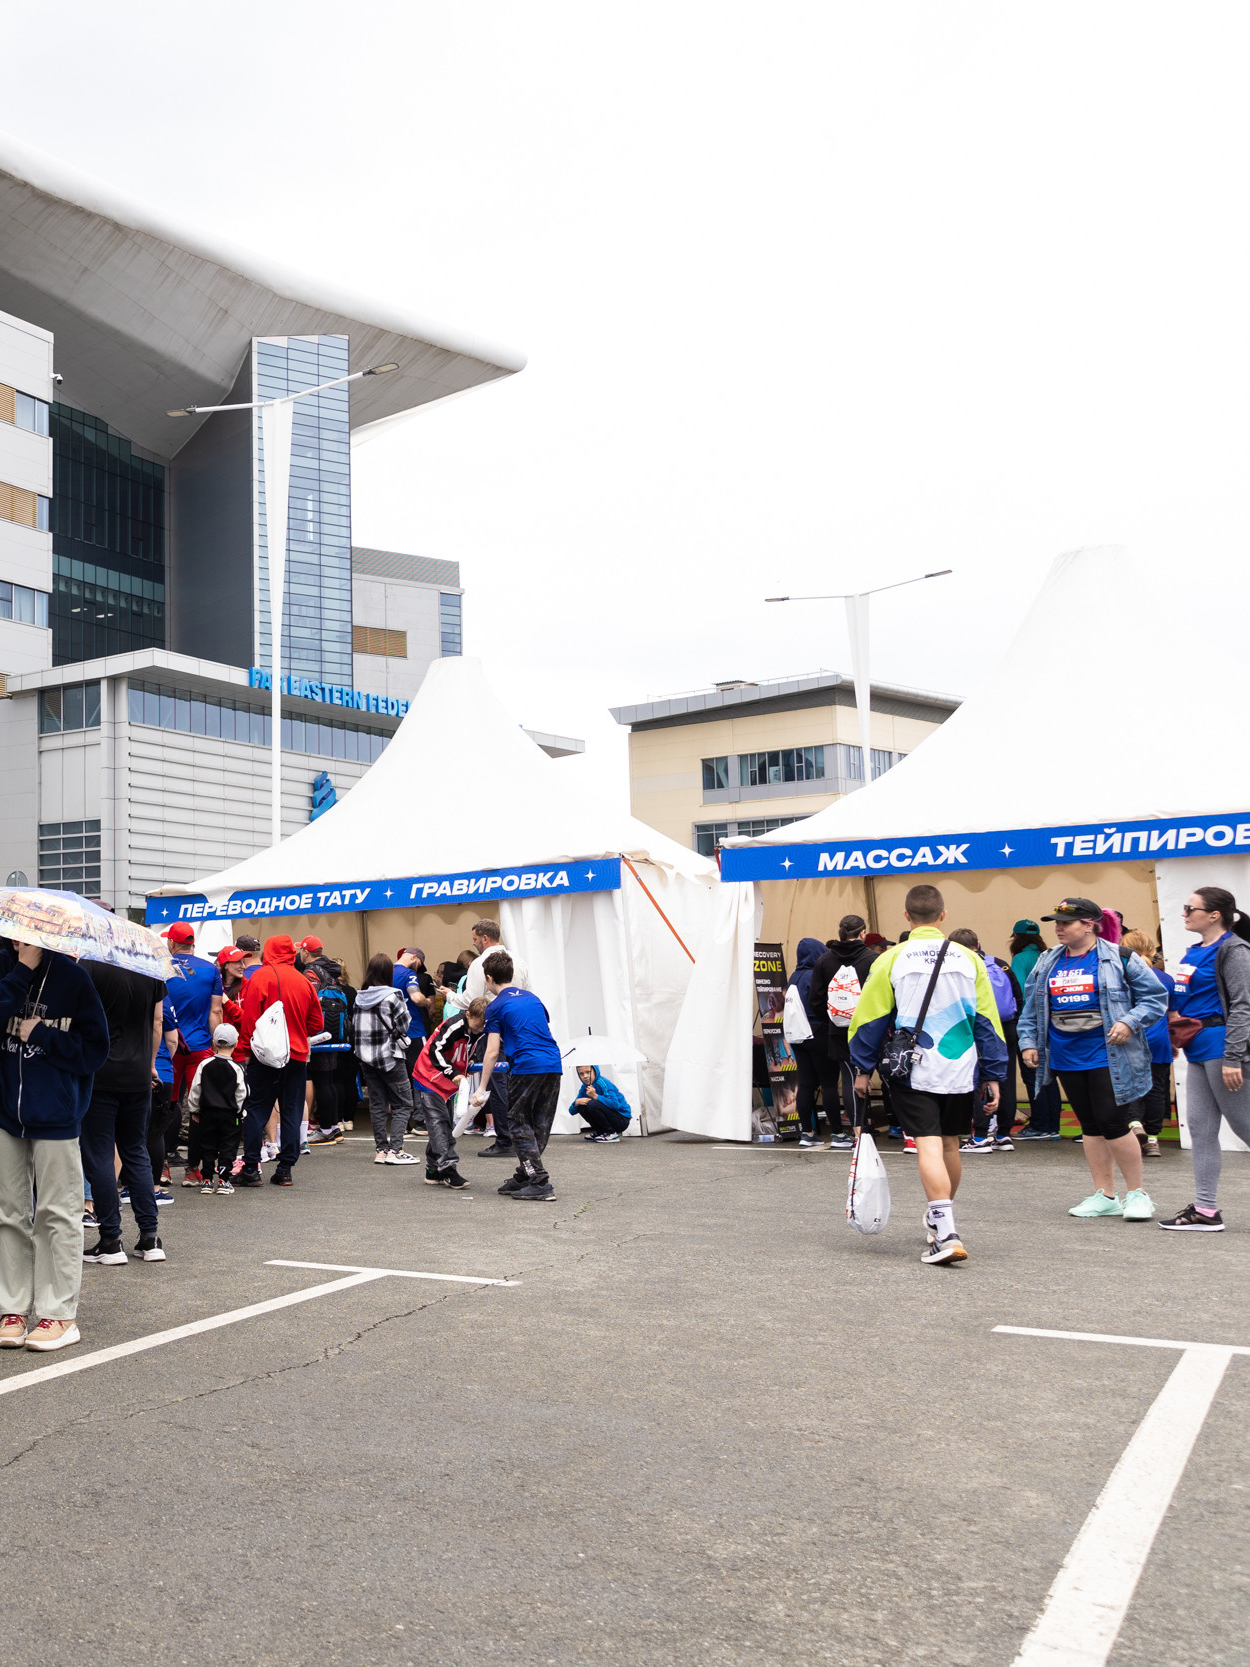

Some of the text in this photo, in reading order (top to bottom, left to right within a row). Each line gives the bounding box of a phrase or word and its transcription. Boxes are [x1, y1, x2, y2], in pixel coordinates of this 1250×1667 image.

[288, 675, 364, 711] EASTERN
[817, 843, 971, 872] МАССАЖ
[410, 870, 570, 899] ГРАВИРОВКА
[178, 887, 371, 918] ПЕРЕВОДНОЕ ТАТУ
[753, 960, 783, 972] ZONE
[906, 950, 961, 959] PRIMOSK
[1057, 994, 1090, 1004] 10198
